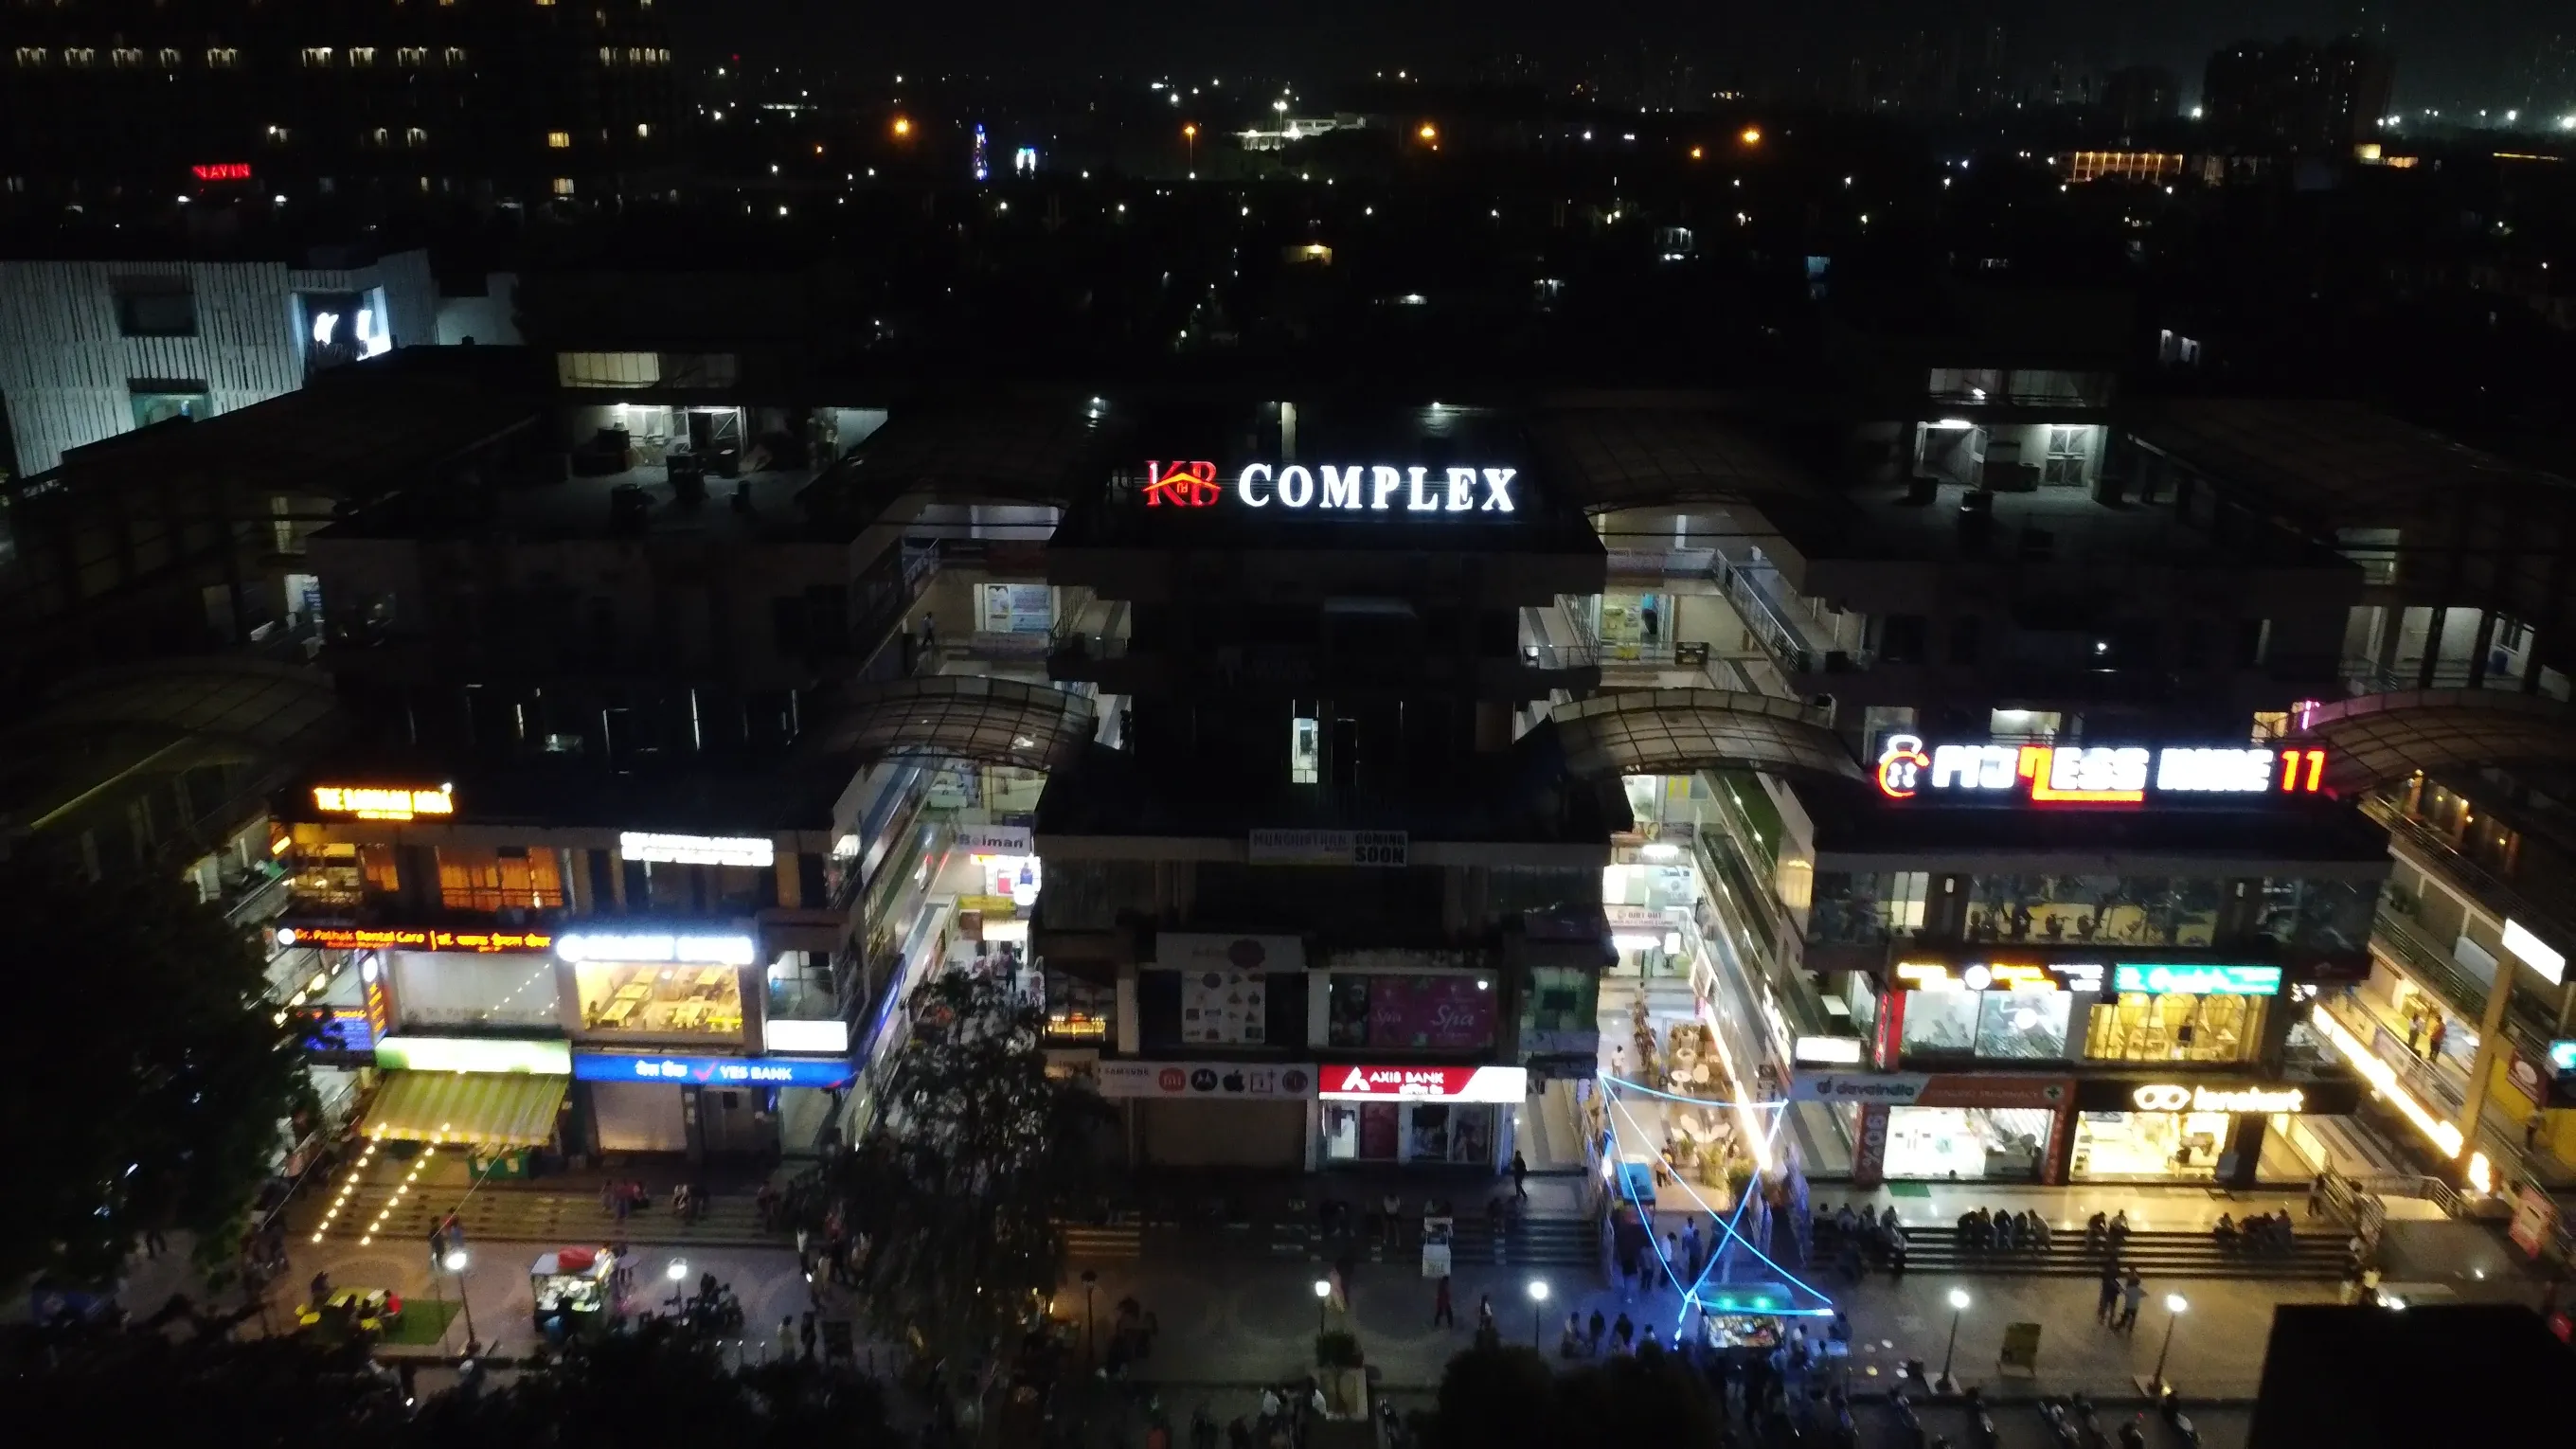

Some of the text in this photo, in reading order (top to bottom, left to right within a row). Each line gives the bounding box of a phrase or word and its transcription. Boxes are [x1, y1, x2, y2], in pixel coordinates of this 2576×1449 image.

[1146, 460, 1517, 512] KB COMPLEX
[2281, 749, 2325, 793] 11
[1355, 832, 1405, 845] COMING
[1354, 846, 1404, 863] SOON
[1430, 1004, 1475, 1033] Spa
[720, 1065, 793, 1081] YES BANK
[1369, 1071, 1444, 1084] AXIS BANK
